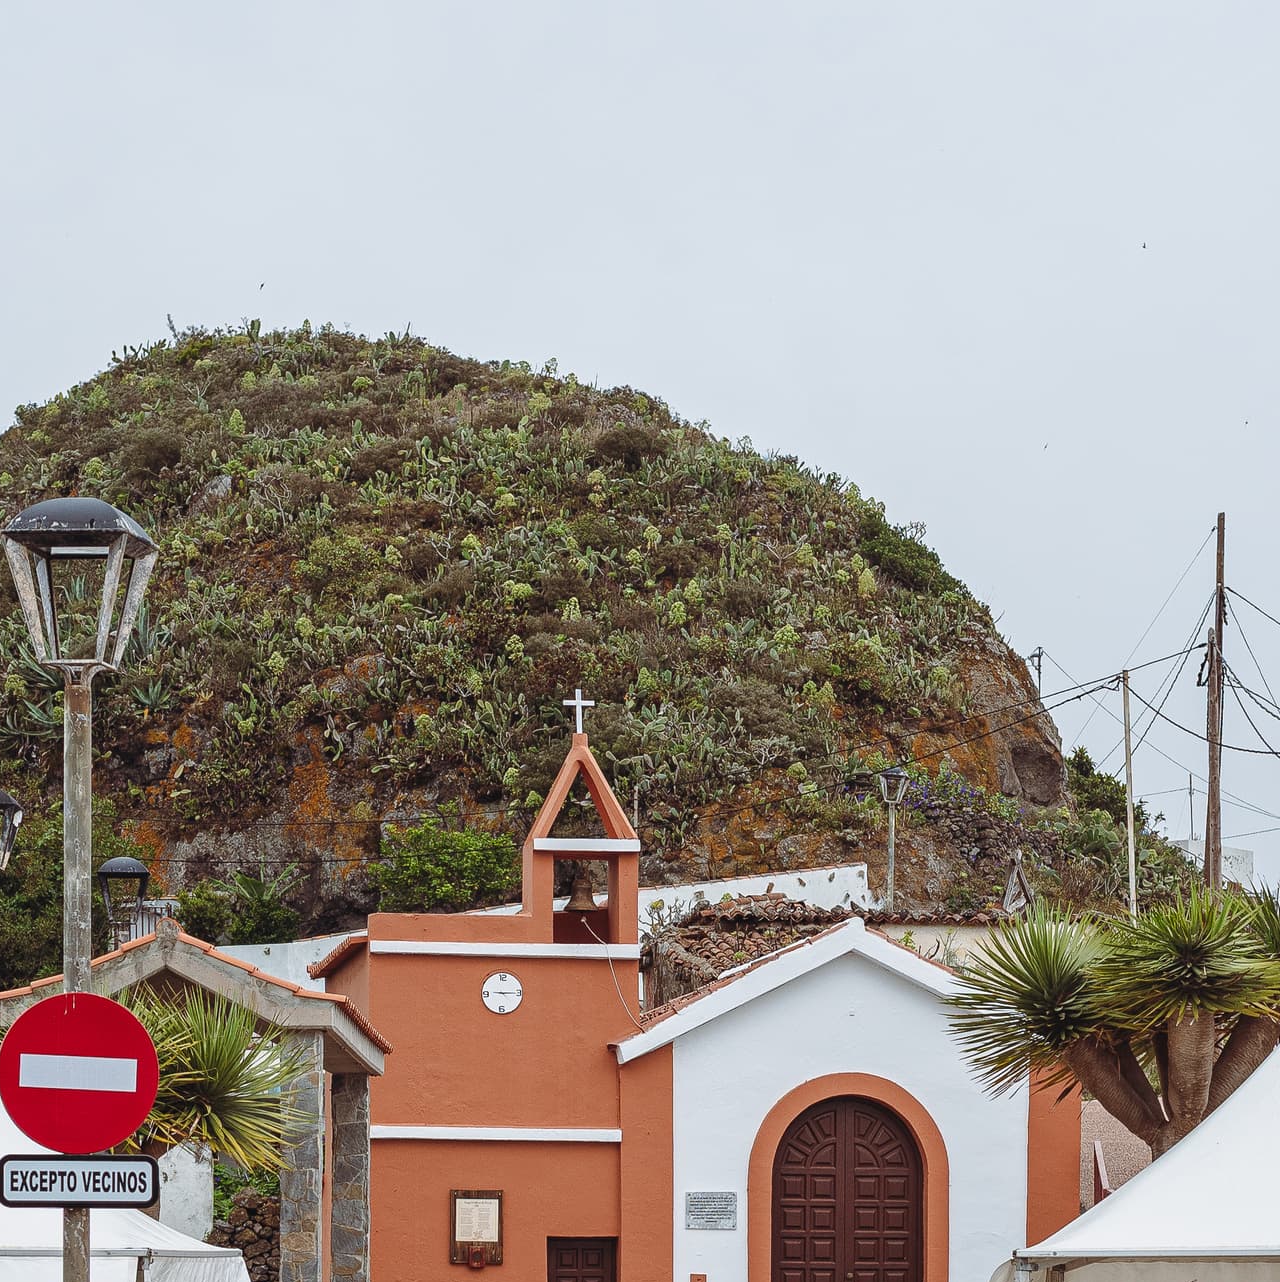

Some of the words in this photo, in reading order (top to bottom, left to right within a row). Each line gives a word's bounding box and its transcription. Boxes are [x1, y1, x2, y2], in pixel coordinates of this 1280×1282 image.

[483, 990, 489, 998] 9
[516, 989, 522, 997] 3
[10, 1170, 77, 1193] EXCEPTO
[82, 1171, 147, 1194] VECINOS
